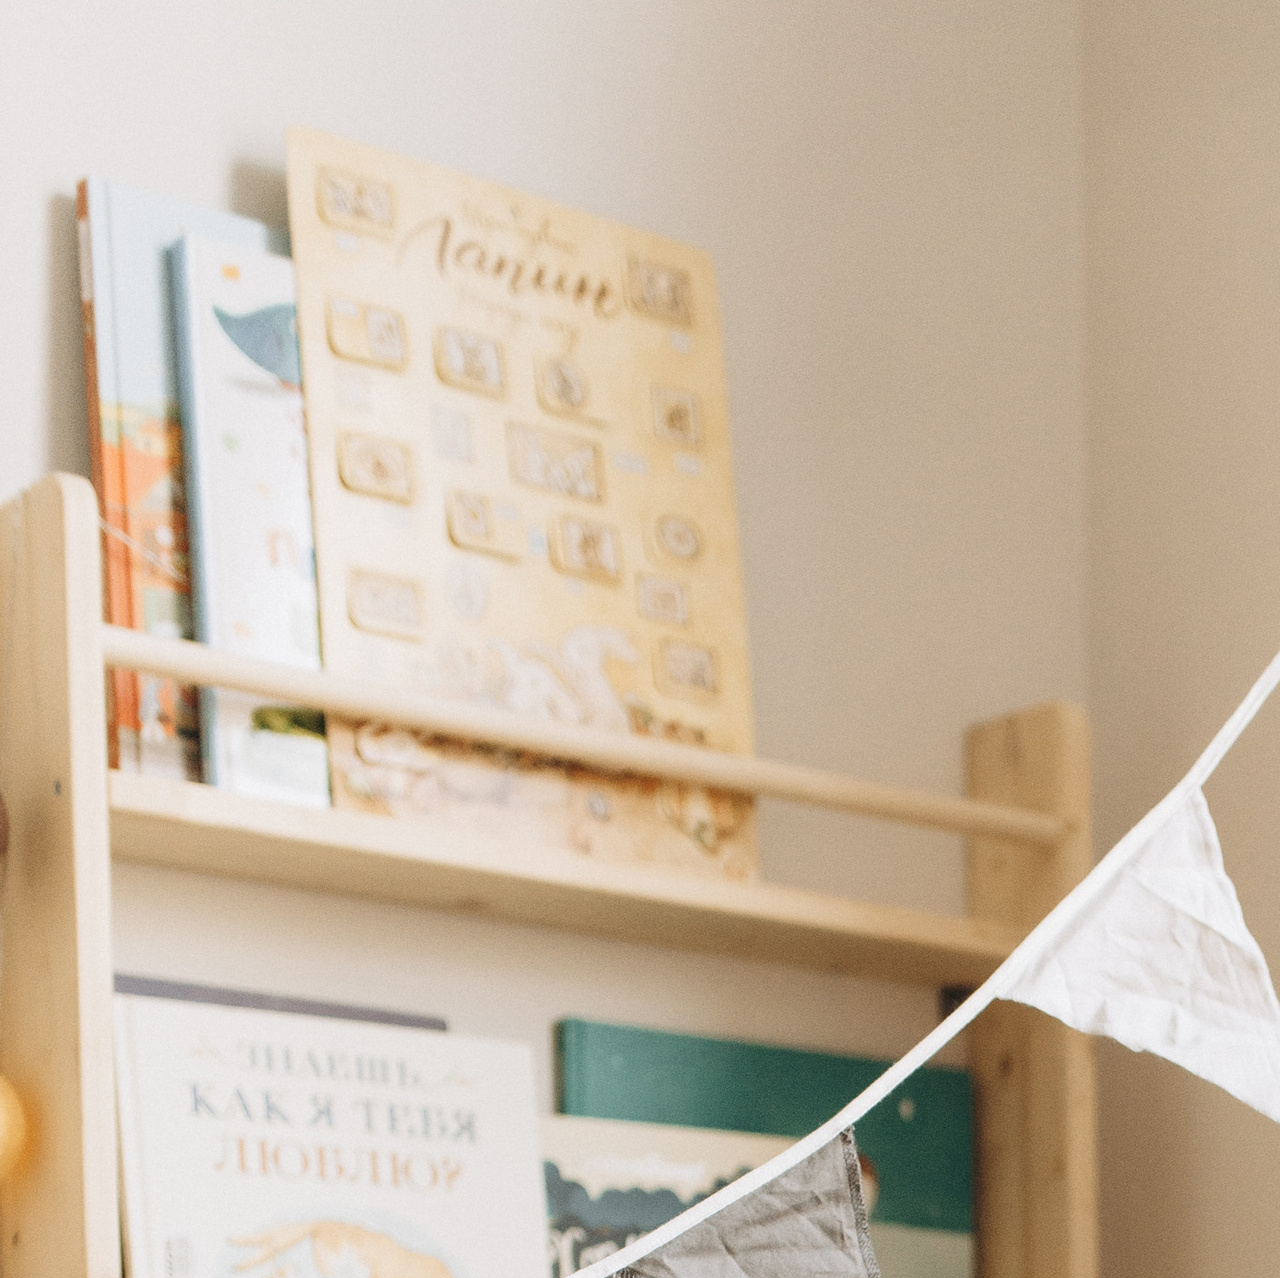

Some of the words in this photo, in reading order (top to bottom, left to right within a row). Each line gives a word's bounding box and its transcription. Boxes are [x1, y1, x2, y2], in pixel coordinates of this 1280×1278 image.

[187, 1082, 293, 1127] КАК
[309, 1094, 334, 1127] Я
[356, 1099, 478, 1144] ТЕБЯ
[213, 1136, 462, 1191] ЛЮБЛЮ?
